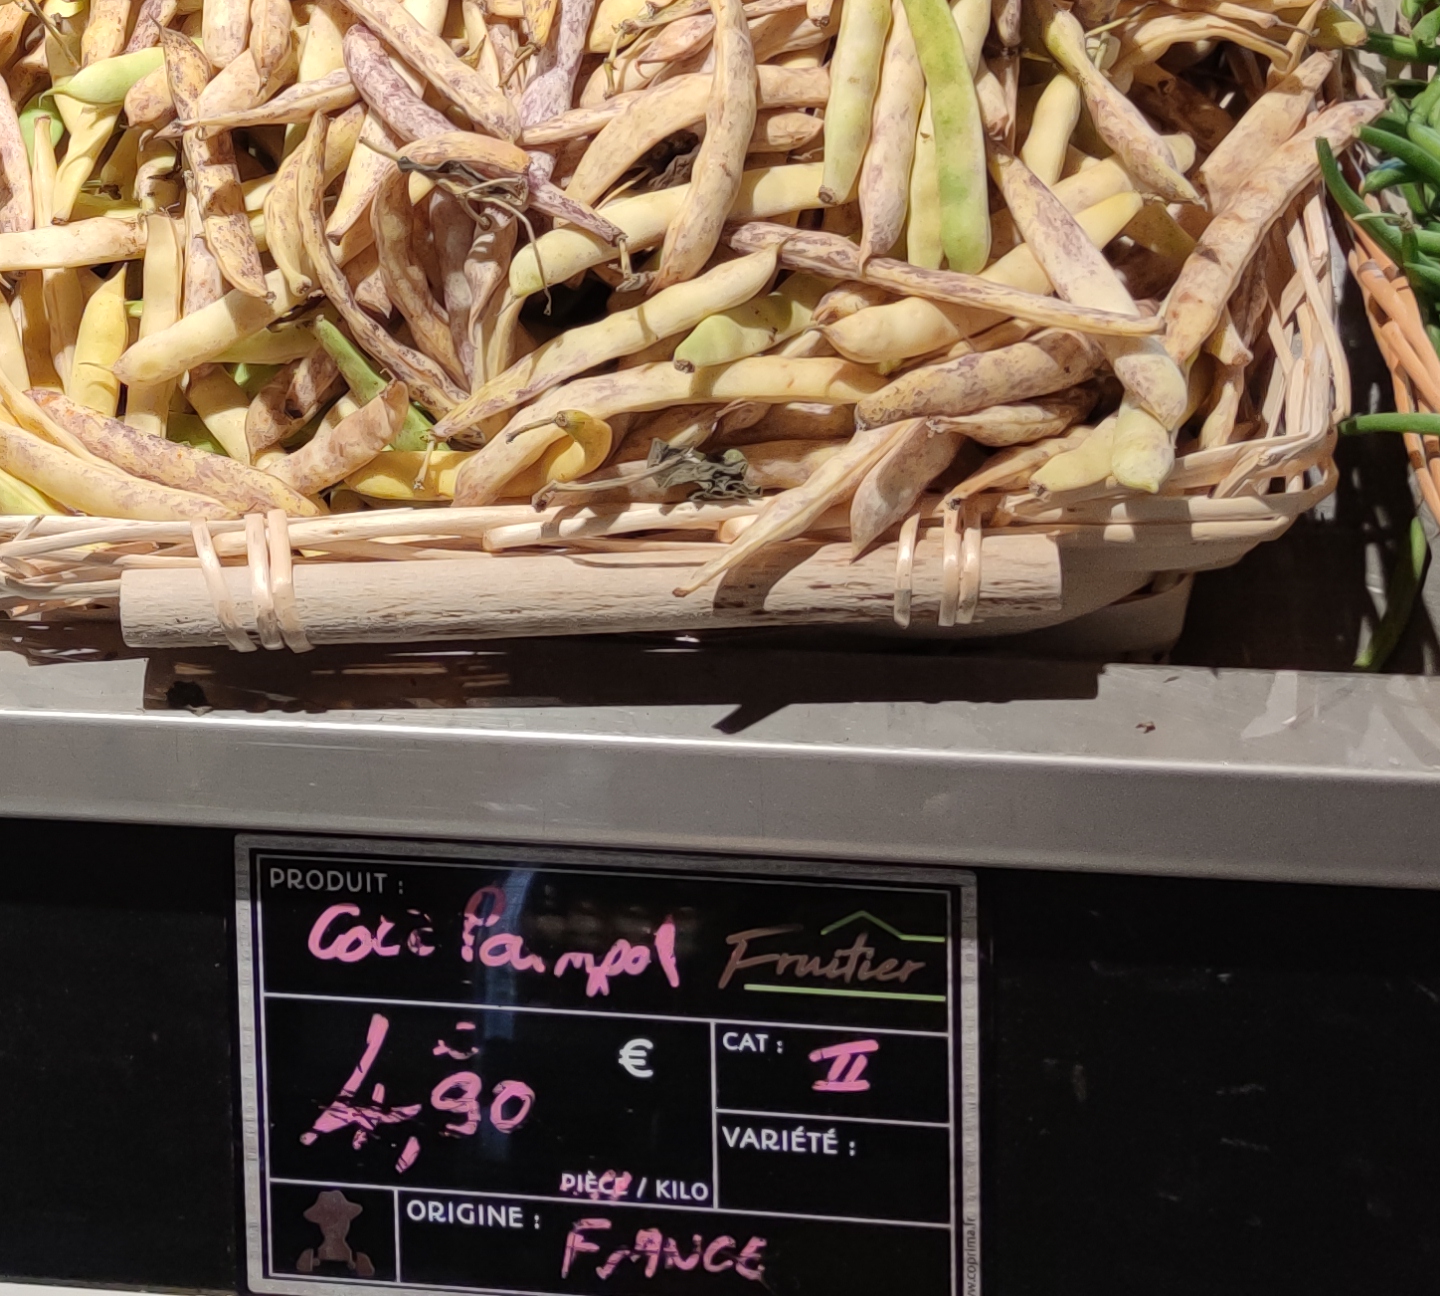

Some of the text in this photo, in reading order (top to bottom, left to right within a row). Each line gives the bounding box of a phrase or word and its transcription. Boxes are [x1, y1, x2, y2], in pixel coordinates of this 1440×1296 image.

[268, 867, 388, 895] PRODUIT
[718, 924, 926, 990] Fruitier
[722, 1030, 770, 1053] CAT
[619, 1038, 654, 1079] €
[721, 1125, 840, 1155] VARIÉTÉ
[656, 1179, 709, 1201] KILO
[406, 1199, 524, 1230] ORIGINE
[963, 1217, 979, 1296] w.coprima.fr
